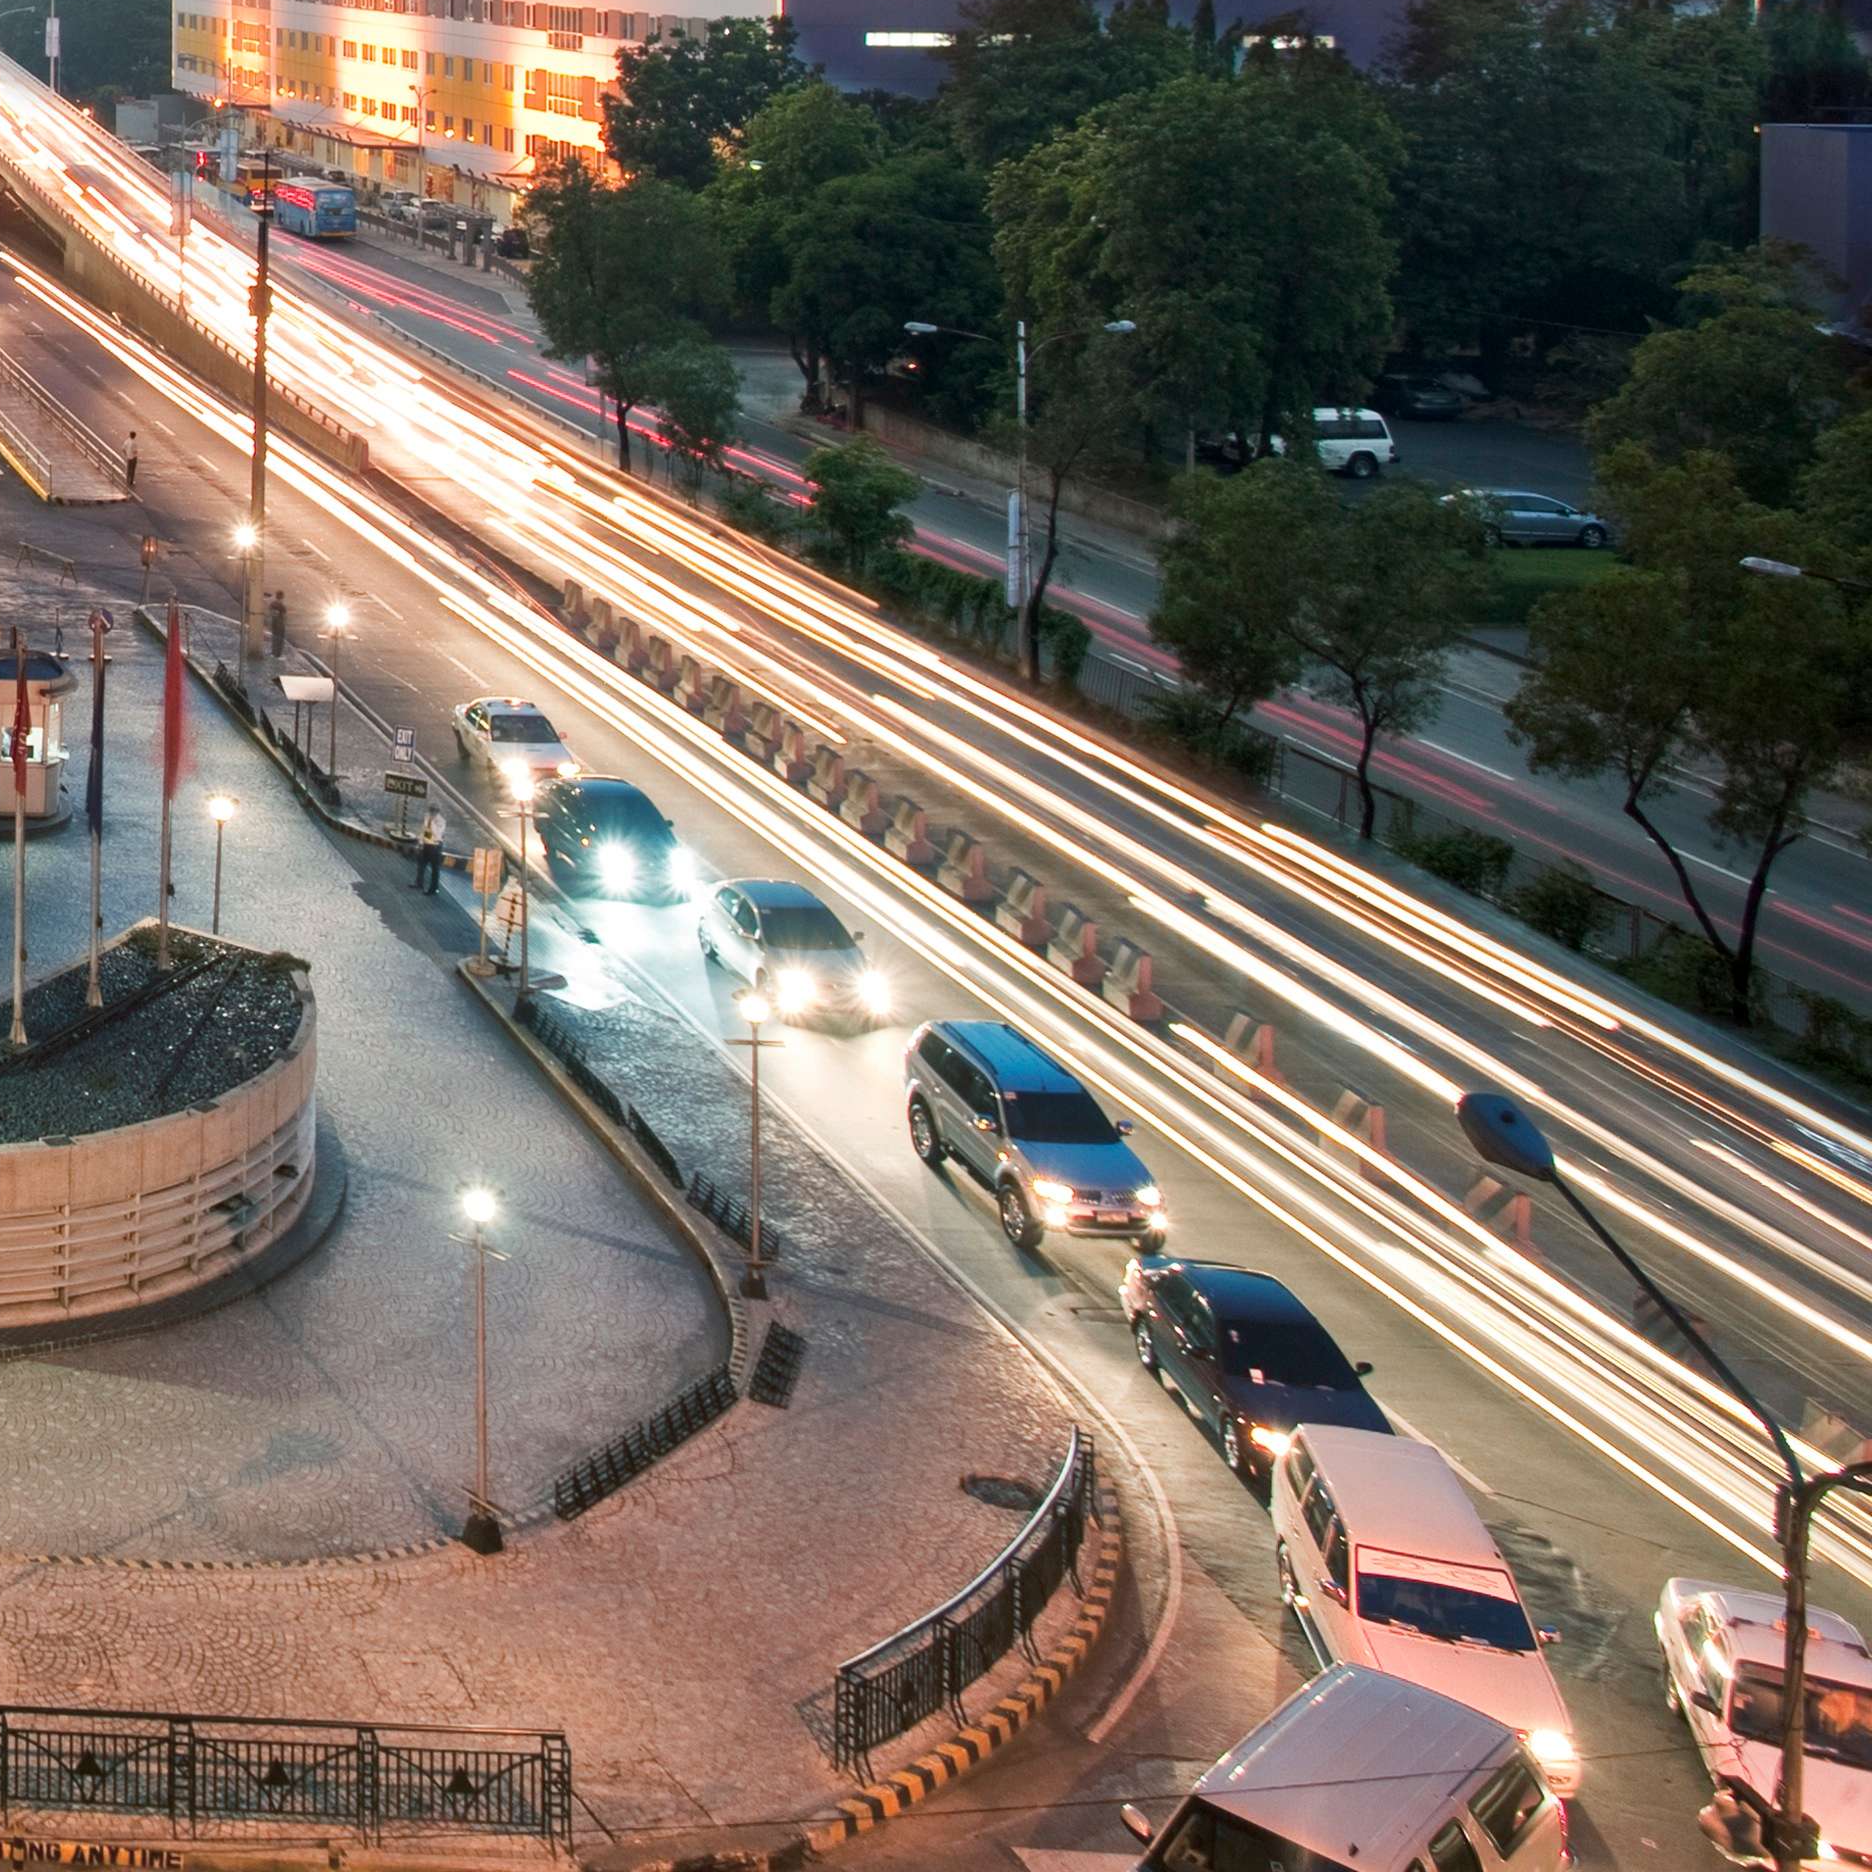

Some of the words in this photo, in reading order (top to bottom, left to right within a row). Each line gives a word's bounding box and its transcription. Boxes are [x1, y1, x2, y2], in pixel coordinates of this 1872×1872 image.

[397, 729, 413, 744] EXIT
[395, 745, 412, 761] ONLY
[71, 1845, 183, 1868] ANYTIME
